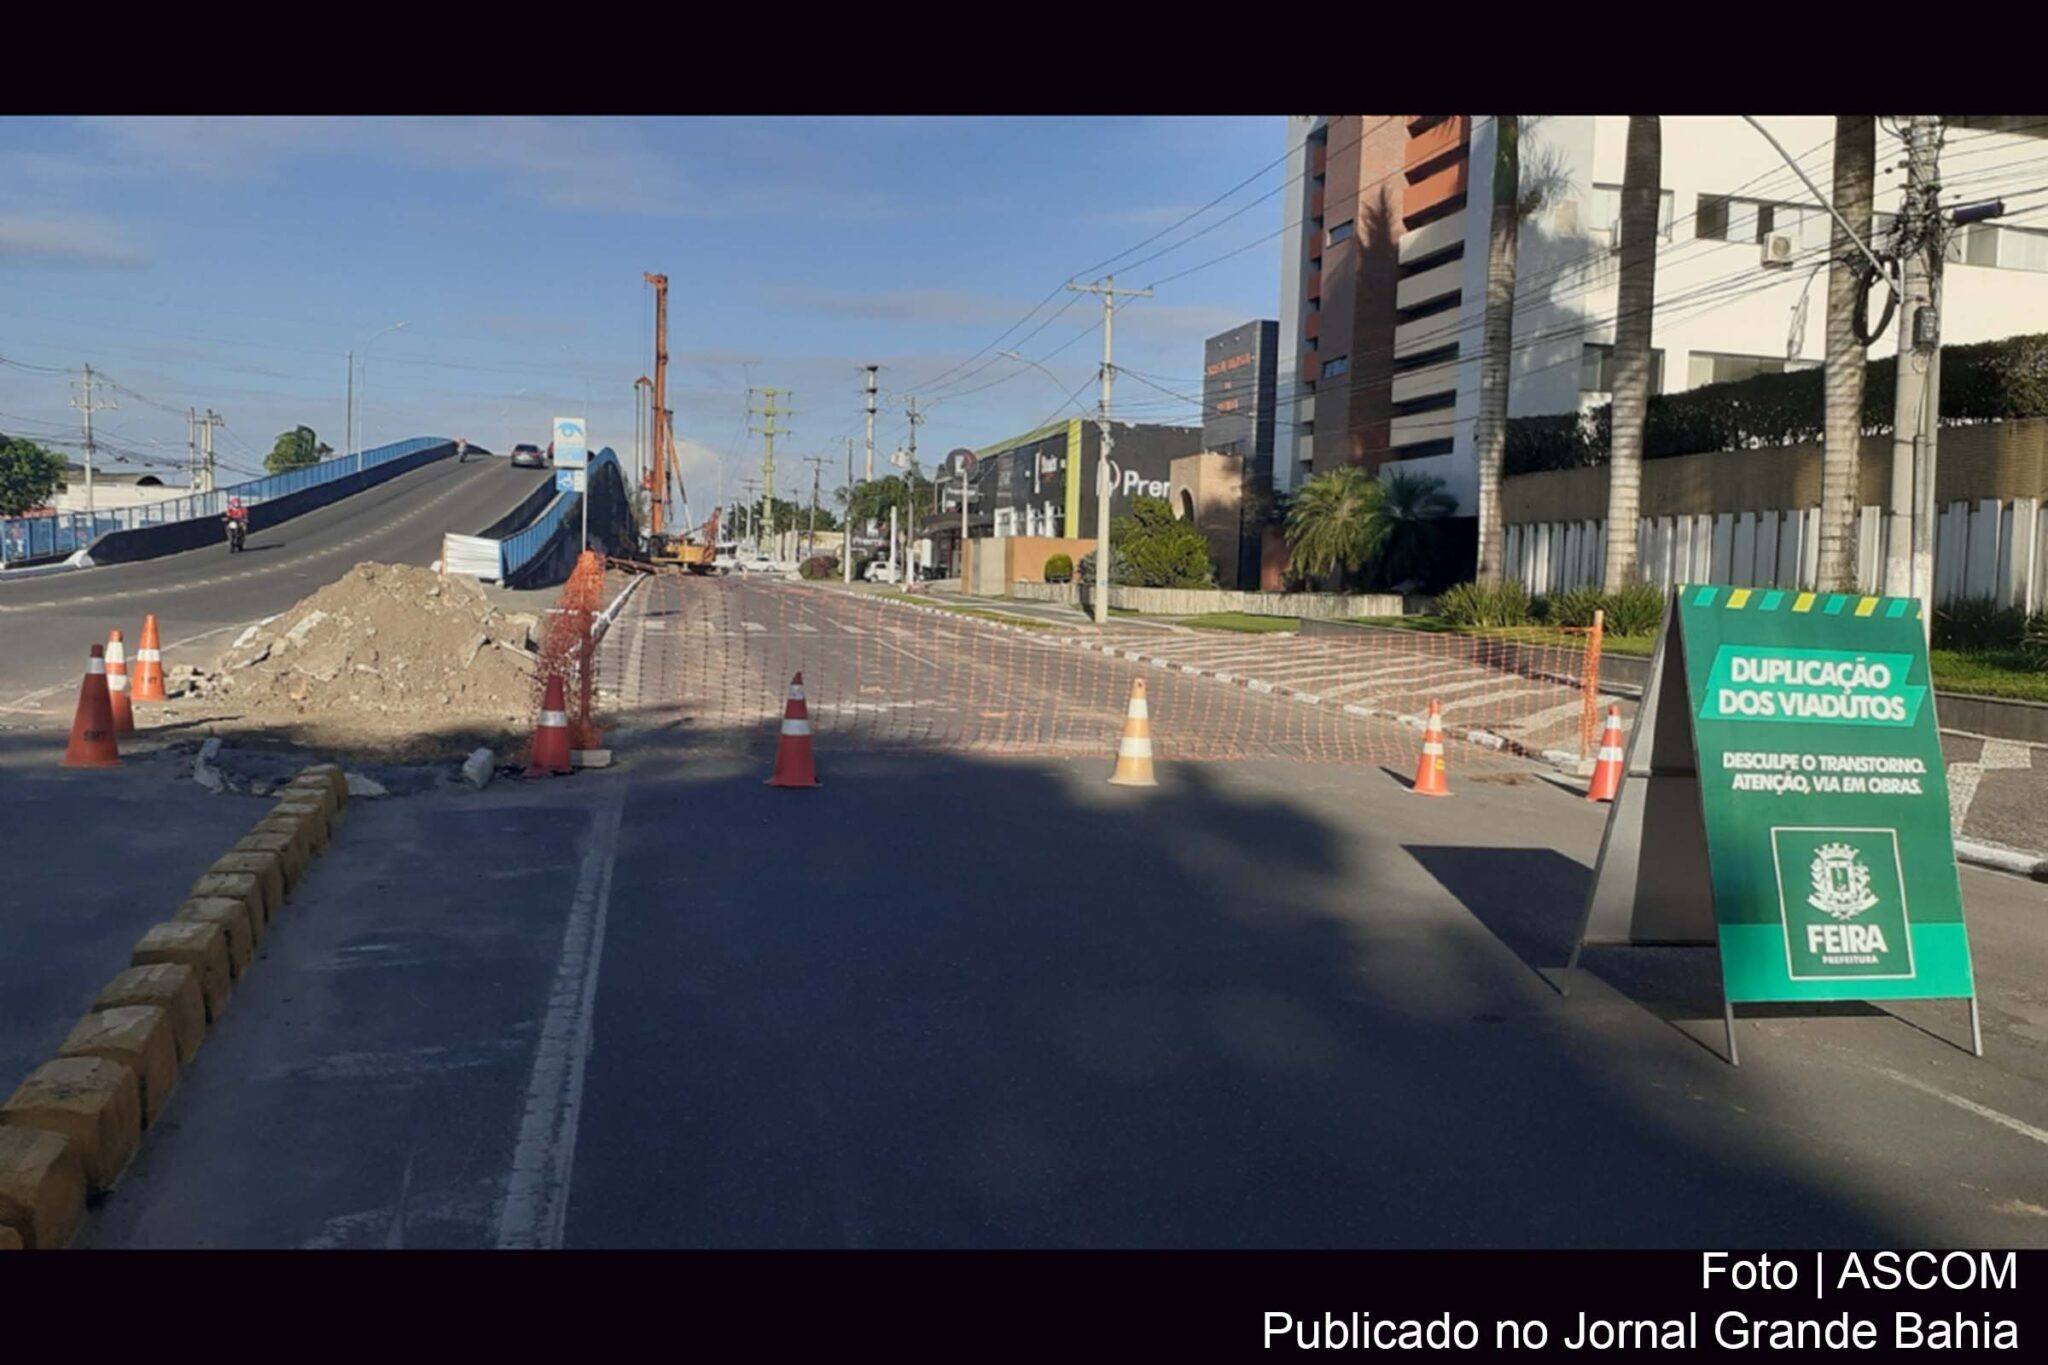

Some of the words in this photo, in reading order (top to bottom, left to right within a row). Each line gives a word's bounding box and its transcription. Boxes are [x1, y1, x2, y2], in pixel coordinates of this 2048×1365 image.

[1731, 656, 1892, 694] DUPLICAÇÃO
[1719, 688, 1777, 716] DOS
[1777, 691, 1907, 721] VIADUTOS
[1722, 751, 1800, 771] DESCULPE
[1801, 754, 1817, 771] O
[1818, 754, 1927, 774] TRANSTORNO.
[1732, 771, 1811, 795] ATENÇÃO,
[1812, 775, 1841, 793] VIA
[1842, 776, 1867, 793] EM
[1868, 777, 1923, 795] OBRAS.
[1806, 923, 1889, 954] FEIRA
[1822, 954, 1880, 965] PREFEITURA
